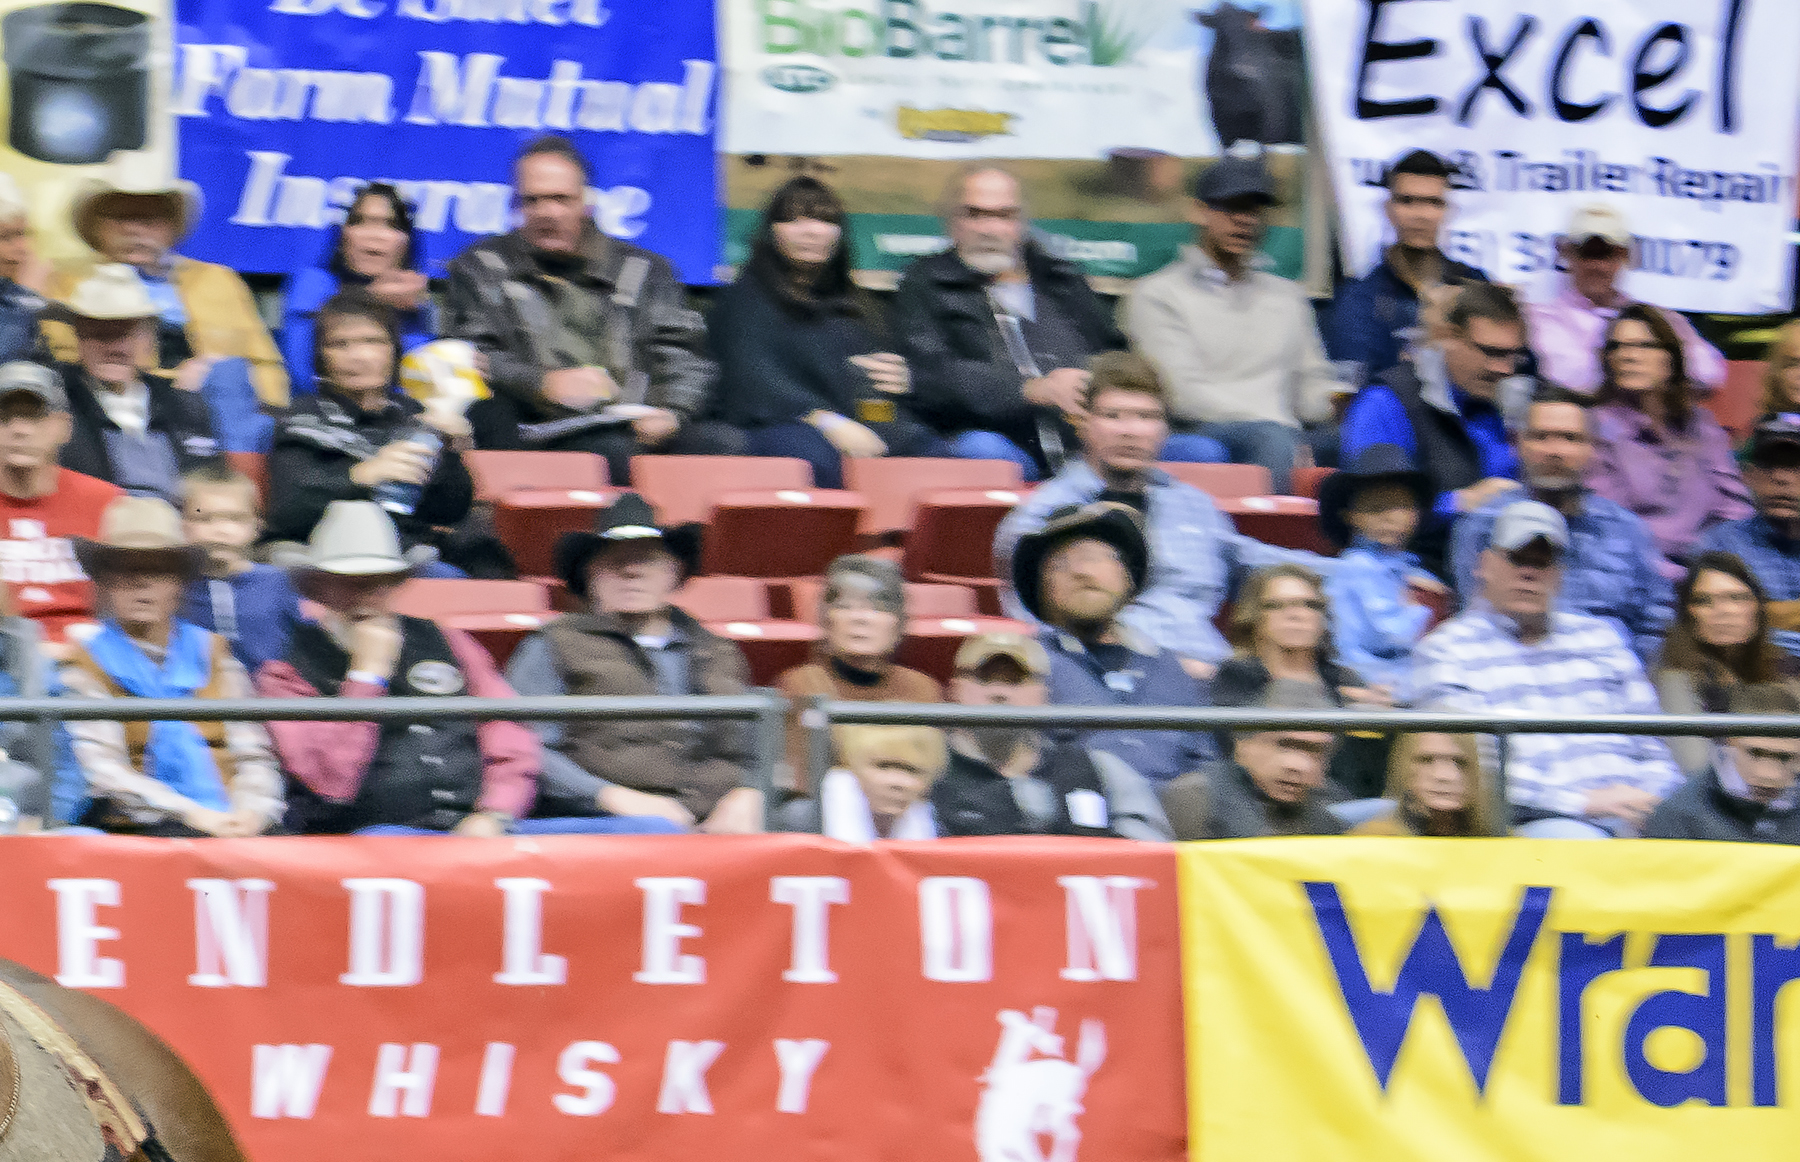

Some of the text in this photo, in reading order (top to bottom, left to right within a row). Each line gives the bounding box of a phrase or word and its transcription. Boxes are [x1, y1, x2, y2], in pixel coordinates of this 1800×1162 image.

[170, 44, 714, 135] Farm Mutual
[1354, 0, 1740, 134] Excel
[1493, 150, 1631, 193] Trailer
[1646, 155, 1788, 212] Repair
[1300, 880, 1800, 1108] Wra
[250, 1036, 832, 1121] WHISKY
